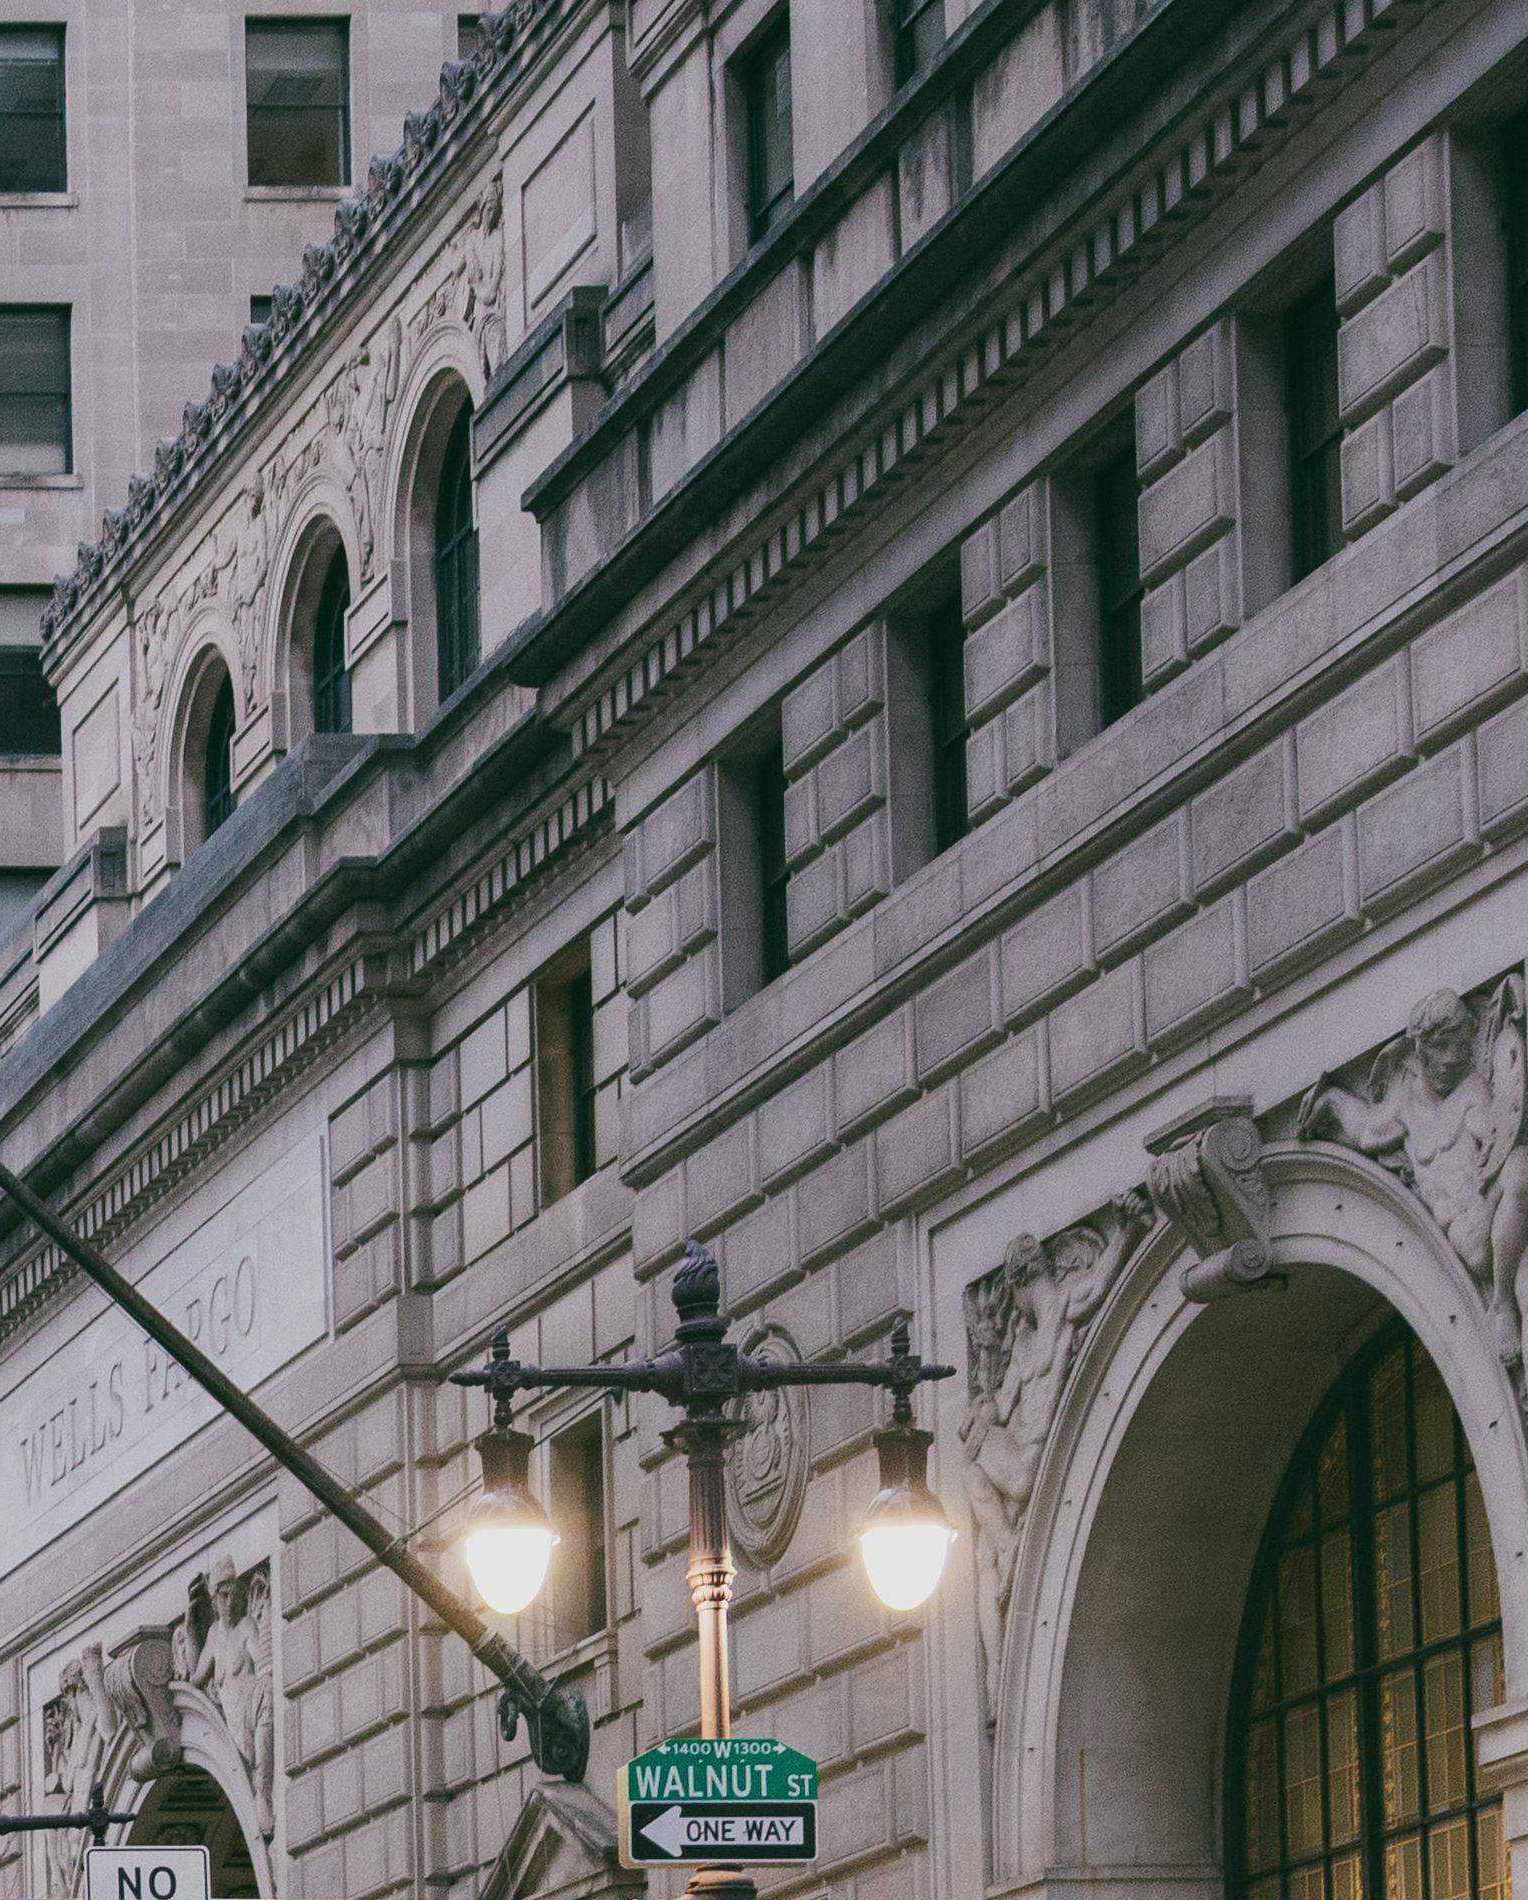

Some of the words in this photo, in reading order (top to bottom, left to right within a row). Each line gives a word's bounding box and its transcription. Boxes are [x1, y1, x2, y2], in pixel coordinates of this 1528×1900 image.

[21, 1364, 124, 1506] WELLS
[673, 1743, 711, 1755] 1400
[713, 1742, 732, 1758] W
[734, 1743, 771, 1755] 1300
[636, 1764, 773, 1798] WALNUT
[788, 1774, 813, 1797] ST
[687, 1820, 735, 1841] ONE
[746, 1820, 796, 1841] WAY
[118, 1866, 176, 1900] NO
